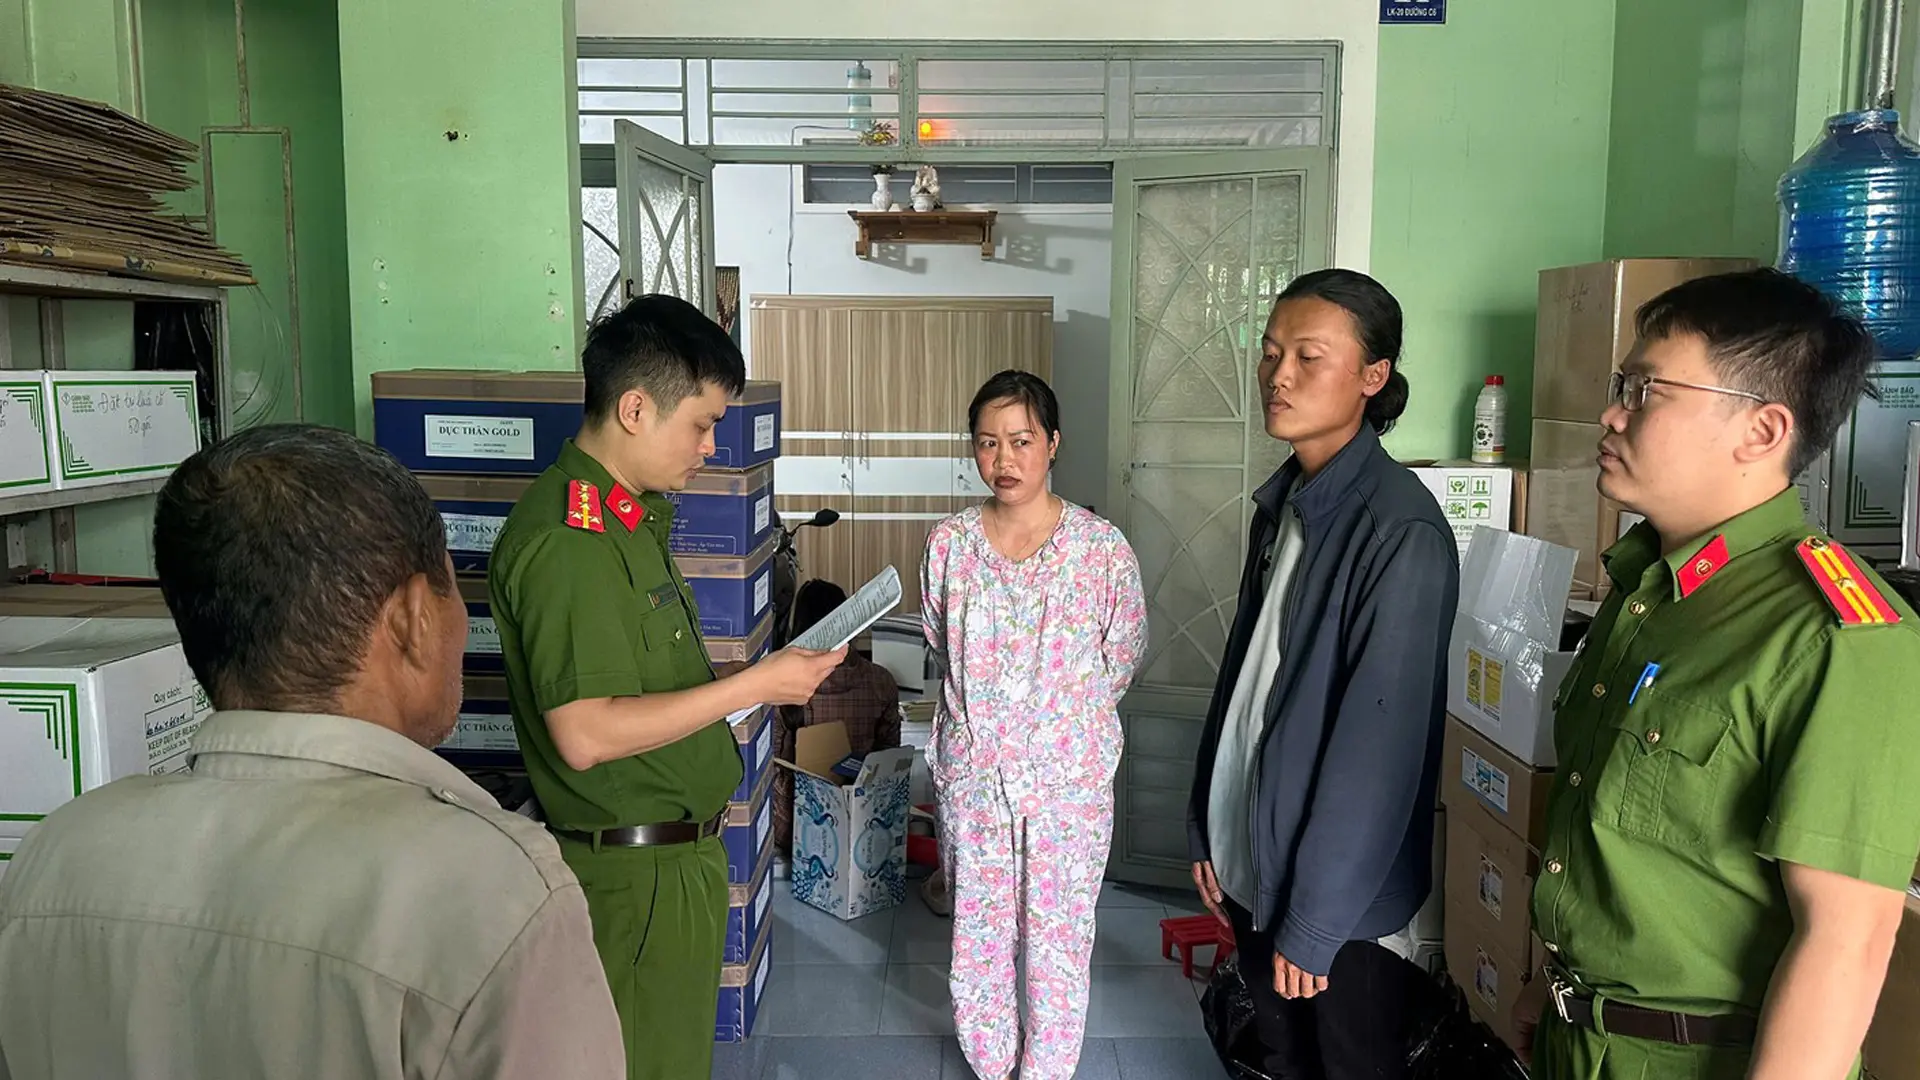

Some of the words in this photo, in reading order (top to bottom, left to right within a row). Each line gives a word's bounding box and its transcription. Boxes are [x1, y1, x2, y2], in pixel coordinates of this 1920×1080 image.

[491, 427, 521, 437] GOLD
[153, 693, 166, 704] Quy
[148, 738, 163, 752] KEEP
